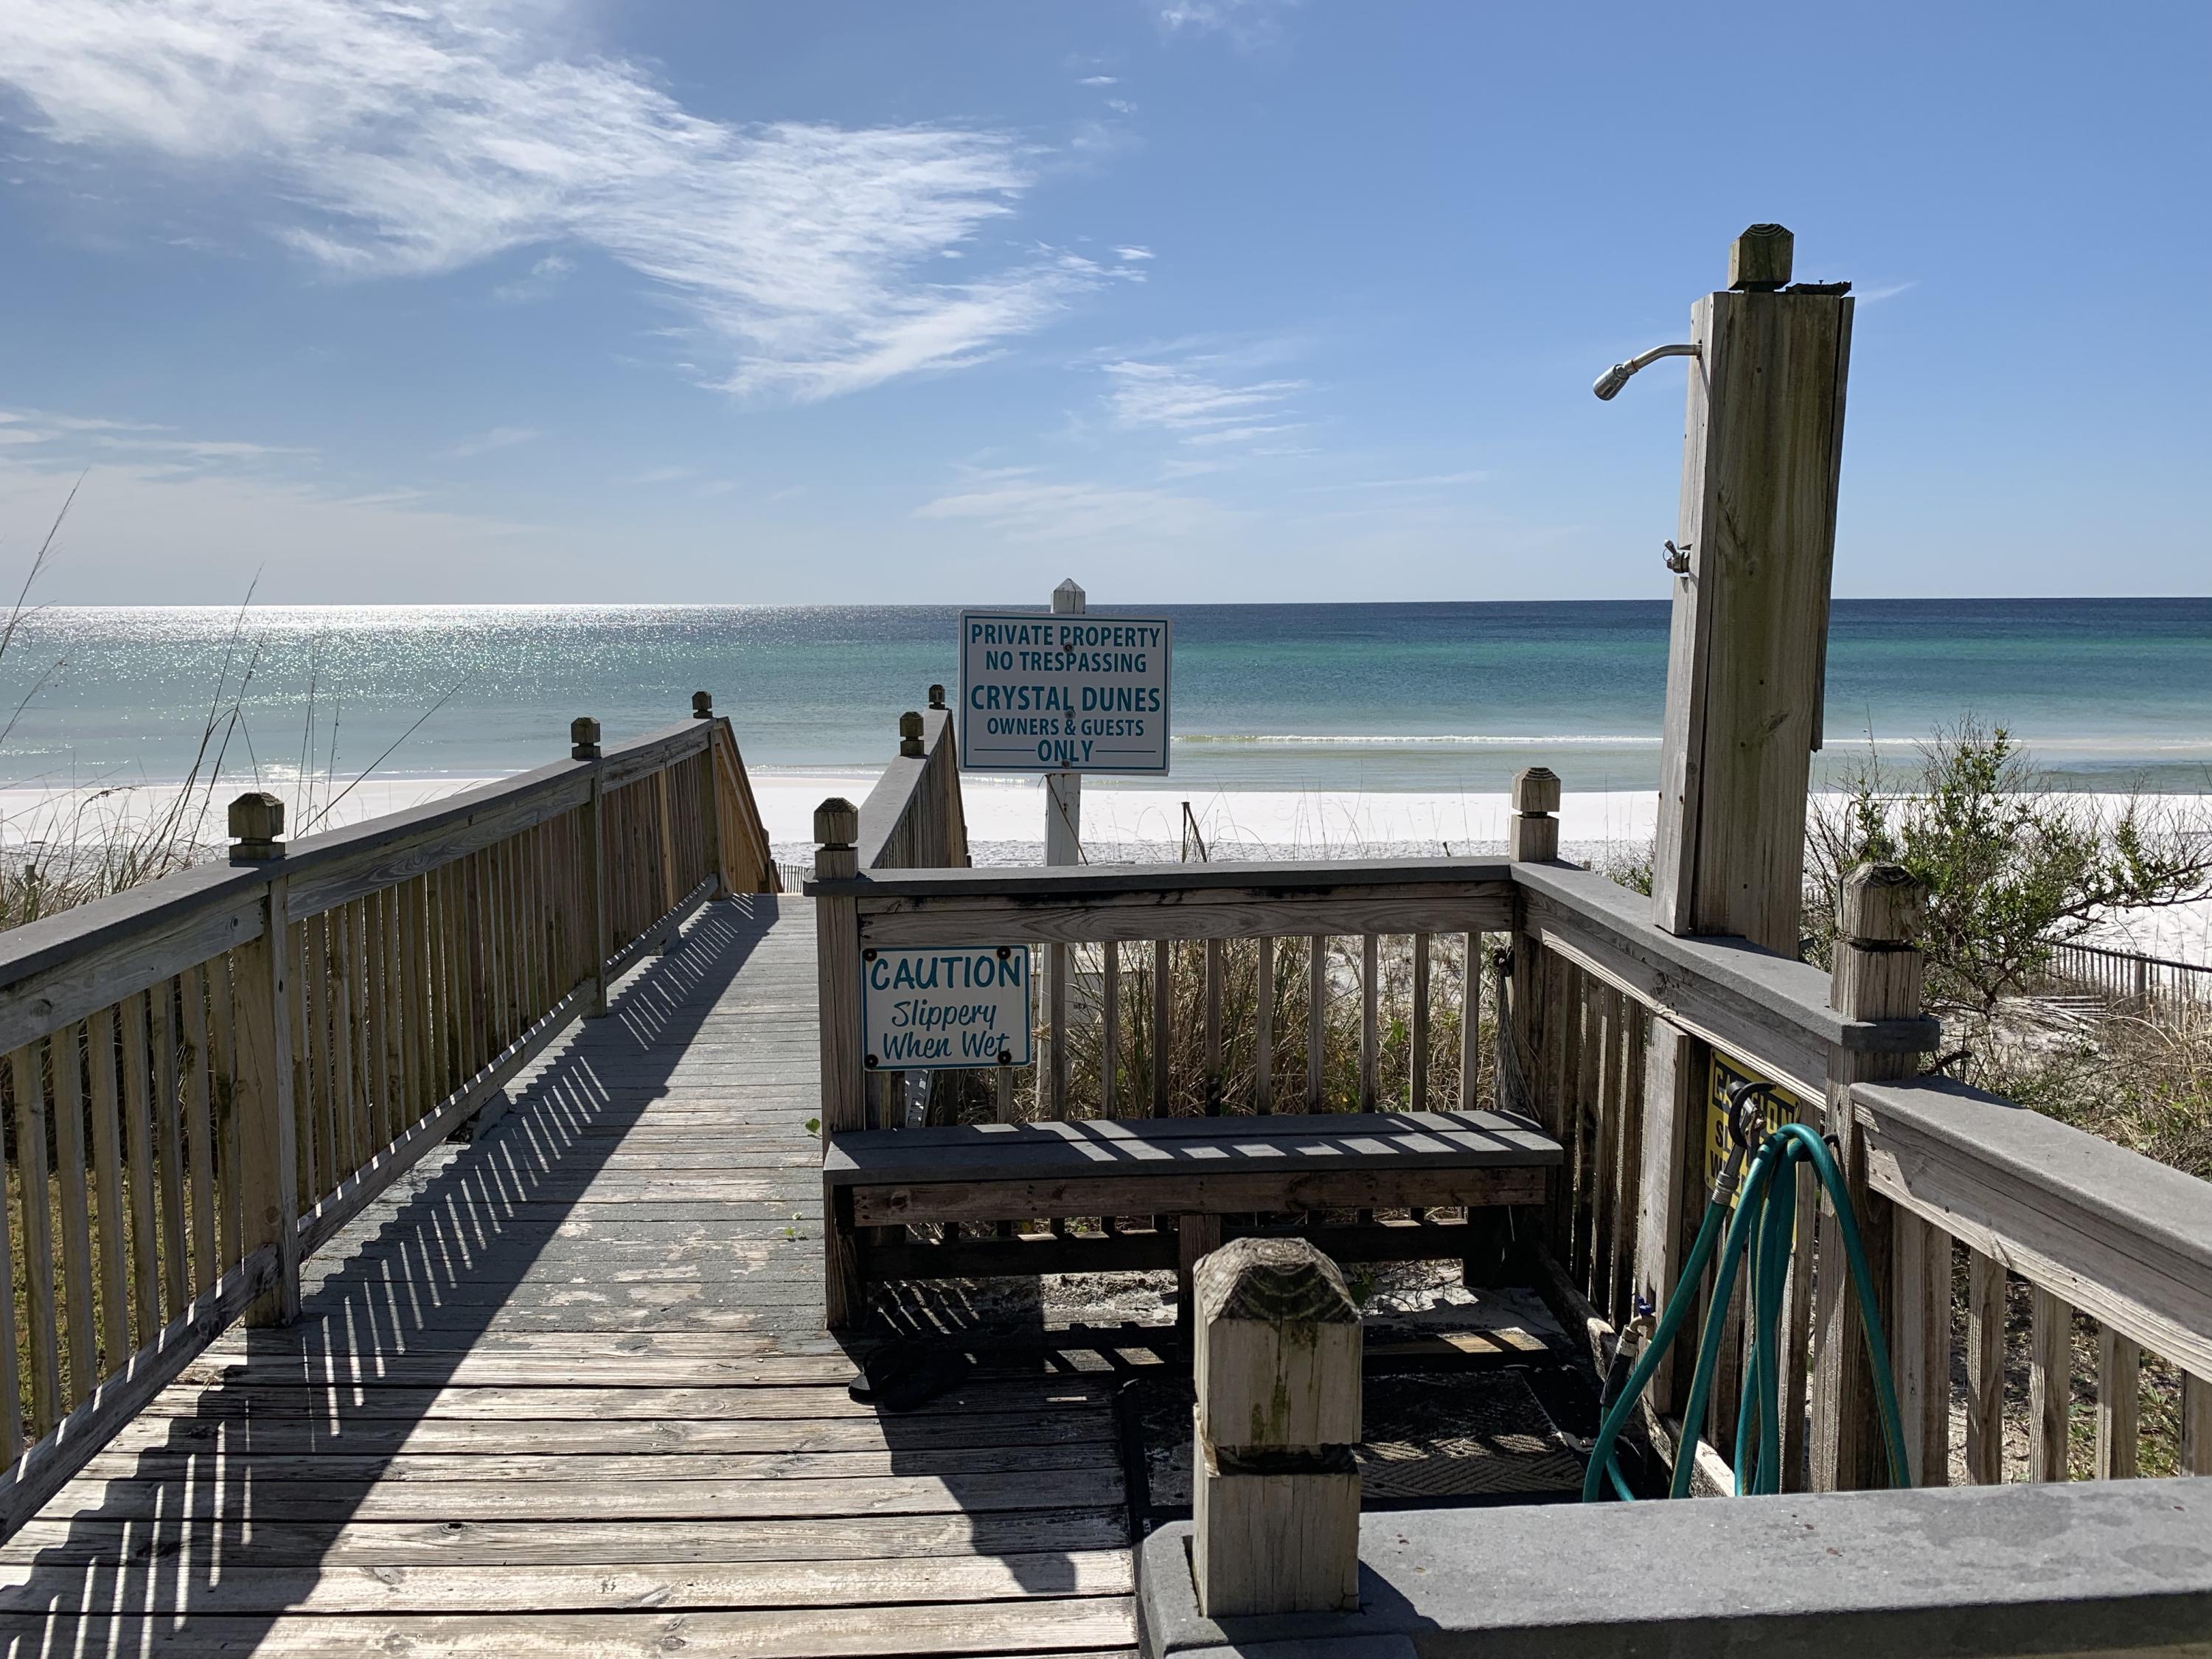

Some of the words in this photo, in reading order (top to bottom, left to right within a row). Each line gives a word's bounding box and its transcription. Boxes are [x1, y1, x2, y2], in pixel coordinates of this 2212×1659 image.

[971, 624, 1054, 645] PRIVATE
[1060, 626, 1161, 647] PROPERTY
[986, 650, 1013, 671] NO
[1019, 651, 1147, 672] TRESPASSING
[970, 684, 1074, 711] CRYSTAL
[1082, 686, 1161, 712] DUNES
[987, 717, 1059, 736] OWNERS
[1064, 718, 1077, 736] &
[1081, 719, 1144, 737] GUESTS
[1037, 740, 1093, 762] ONLY
[871, 955, 1021, 991] CAUTION
[891, 999, 997, 1032] Slippery
[883, 1031, 952, 1060] When
[961, 1030, 1010, 1058] Wet
